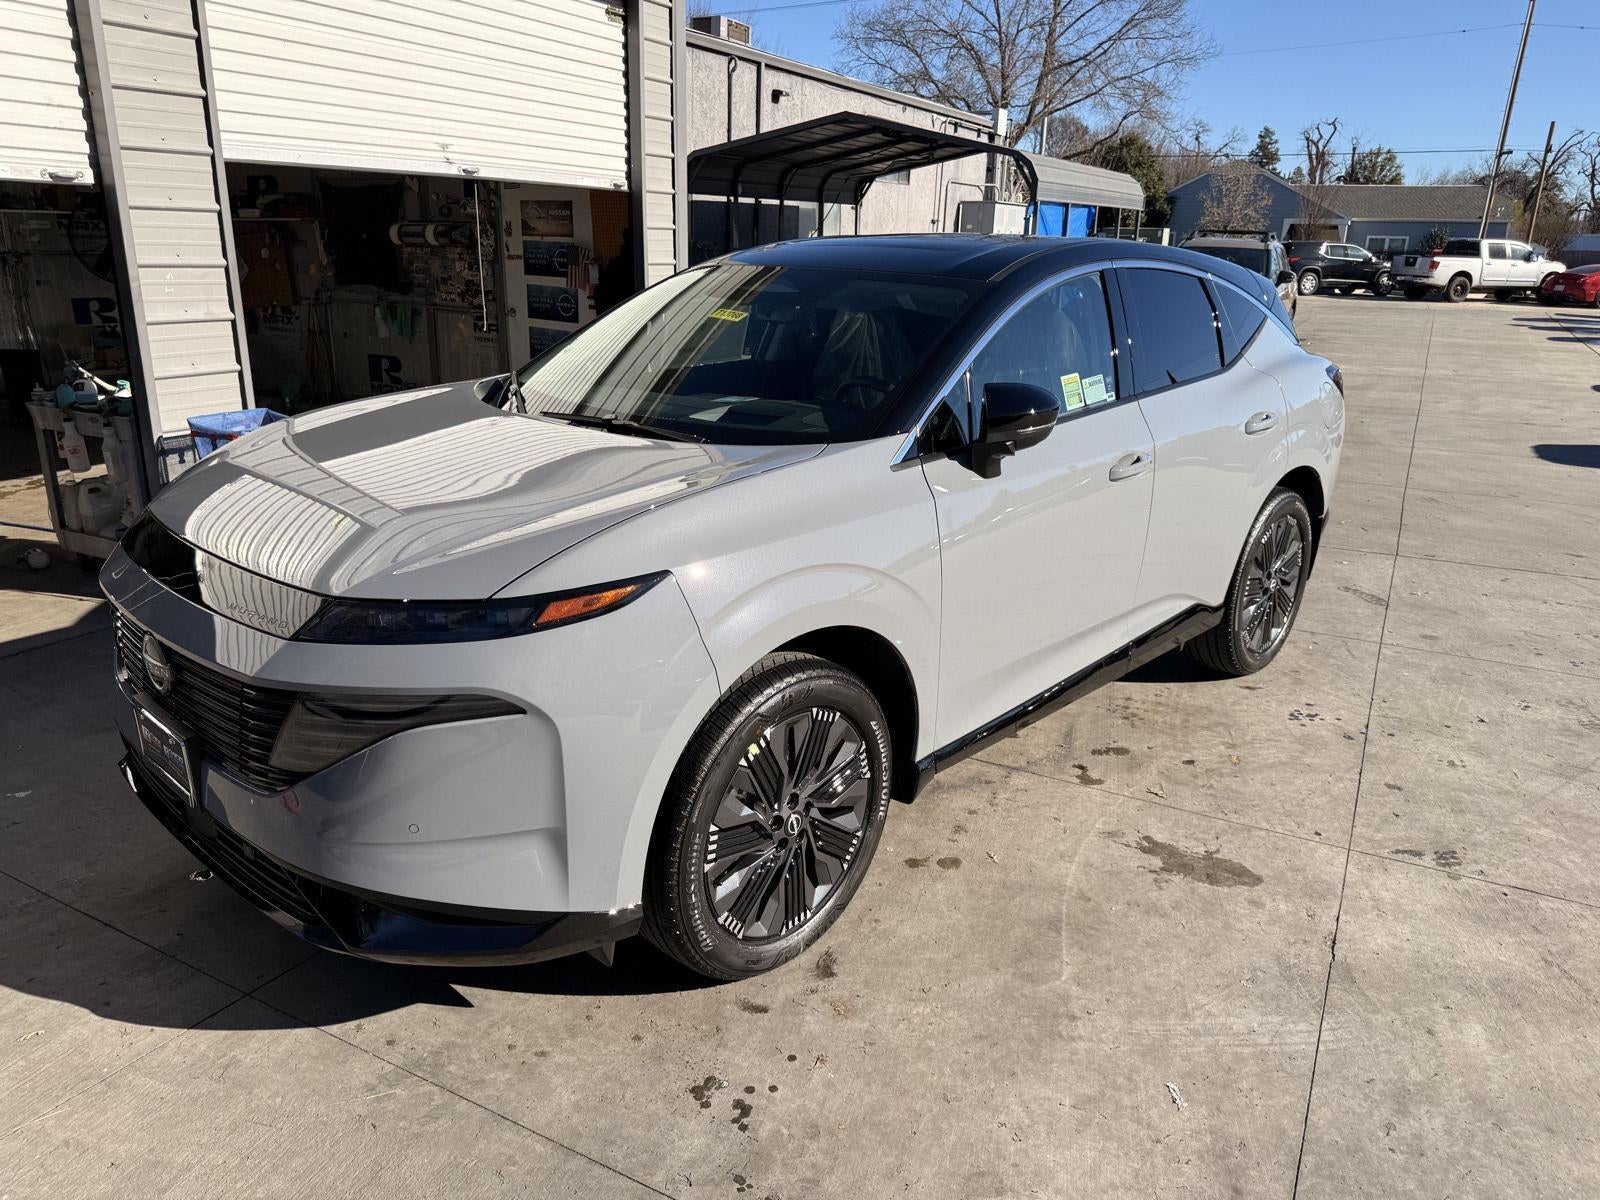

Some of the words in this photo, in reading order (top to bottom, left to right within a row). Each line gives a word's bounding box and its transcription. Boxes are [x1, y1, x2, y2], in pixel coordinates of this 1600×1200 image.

[548, 207, 571, 216] NISSAN
[229, 602, 289, 629] MURANO
[869, 720, 889, 821] BRIDGESTONE
